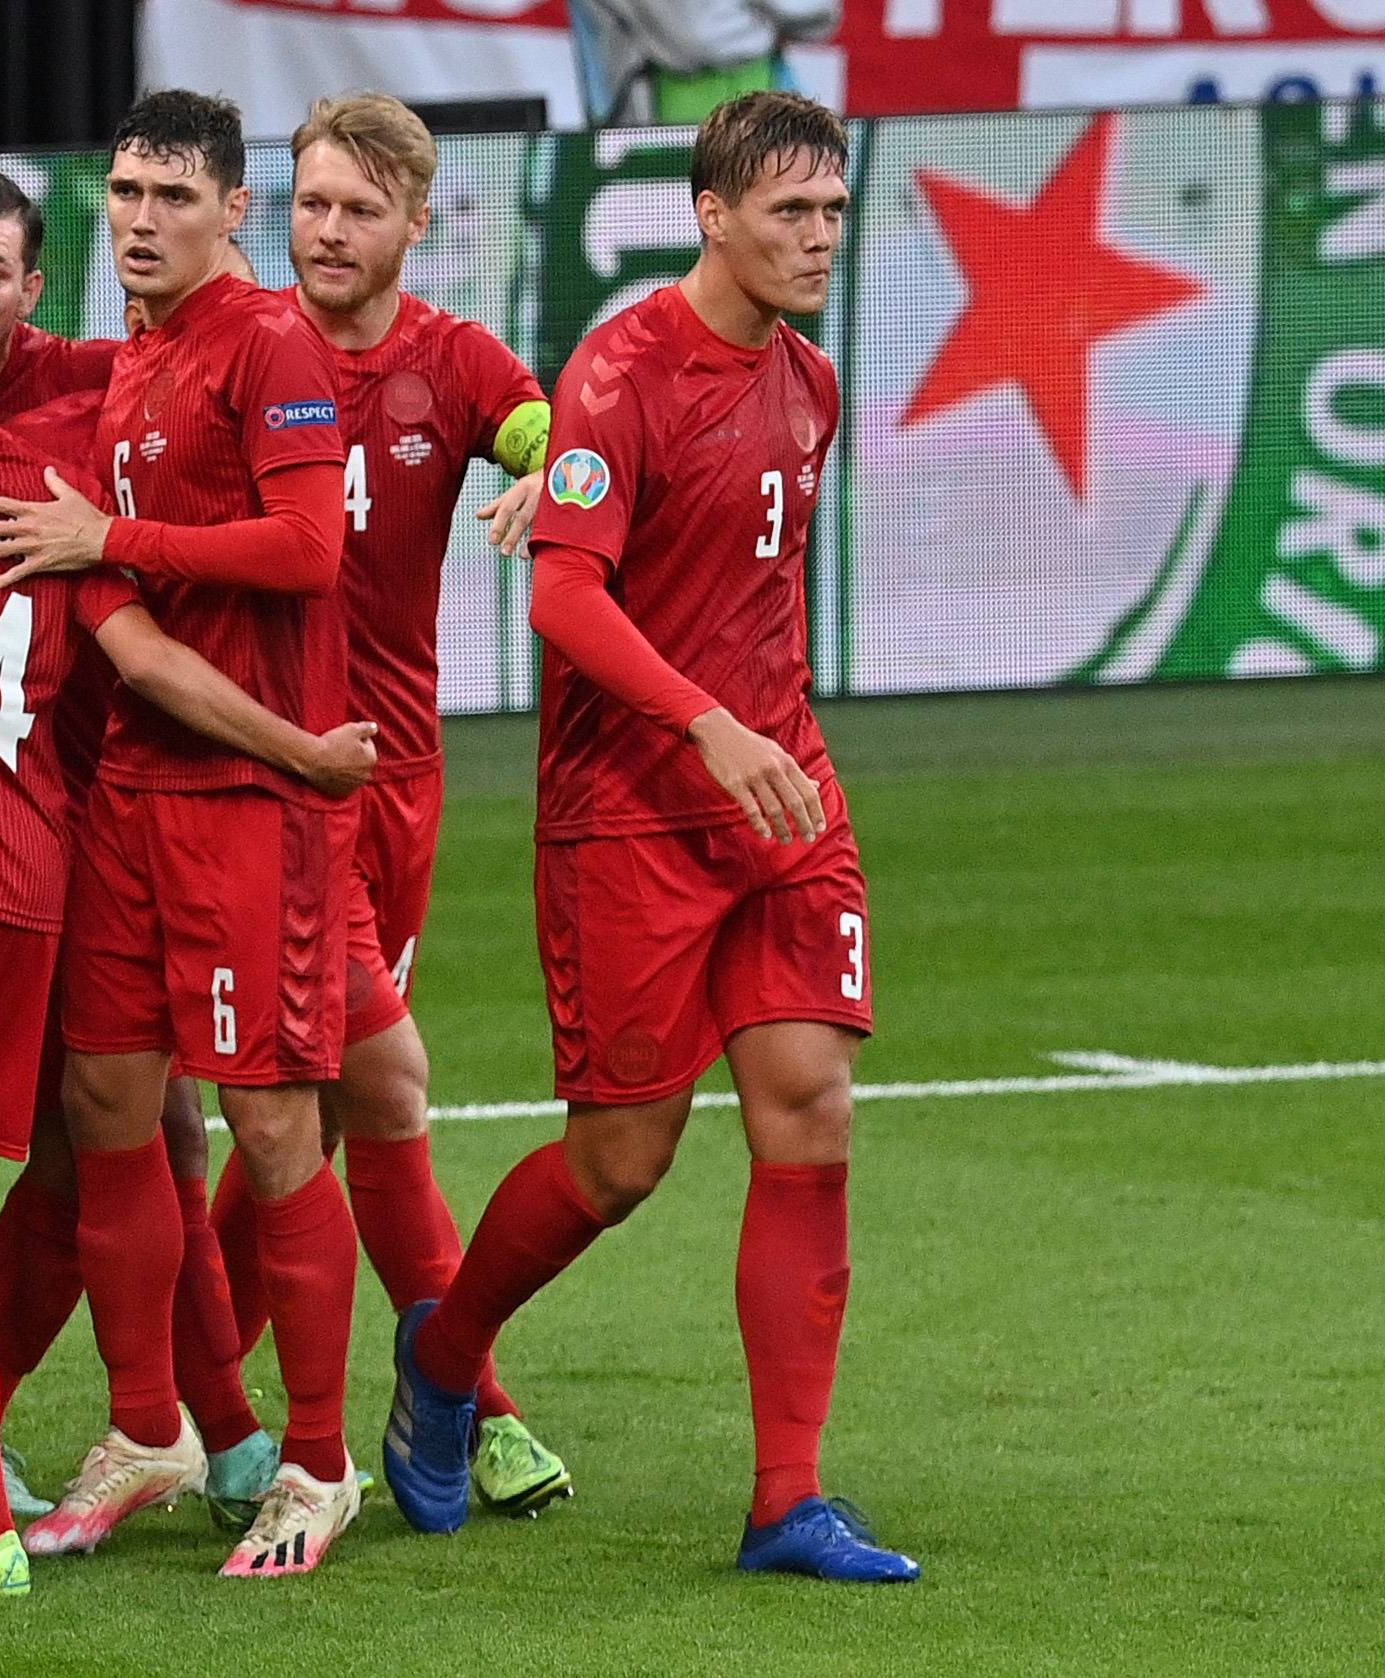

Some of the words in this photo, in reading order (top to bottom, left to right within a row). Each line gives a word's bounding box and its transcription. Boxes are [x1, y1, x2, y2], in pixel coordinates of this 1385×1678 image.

[286, 406, 334, 420] RESPECT
[344, 444, 372, 532] 4
[755, 470, 783, 558] 3
[839, 911, 864, 1001] 3
[211, 967, 237, 1055] 6
